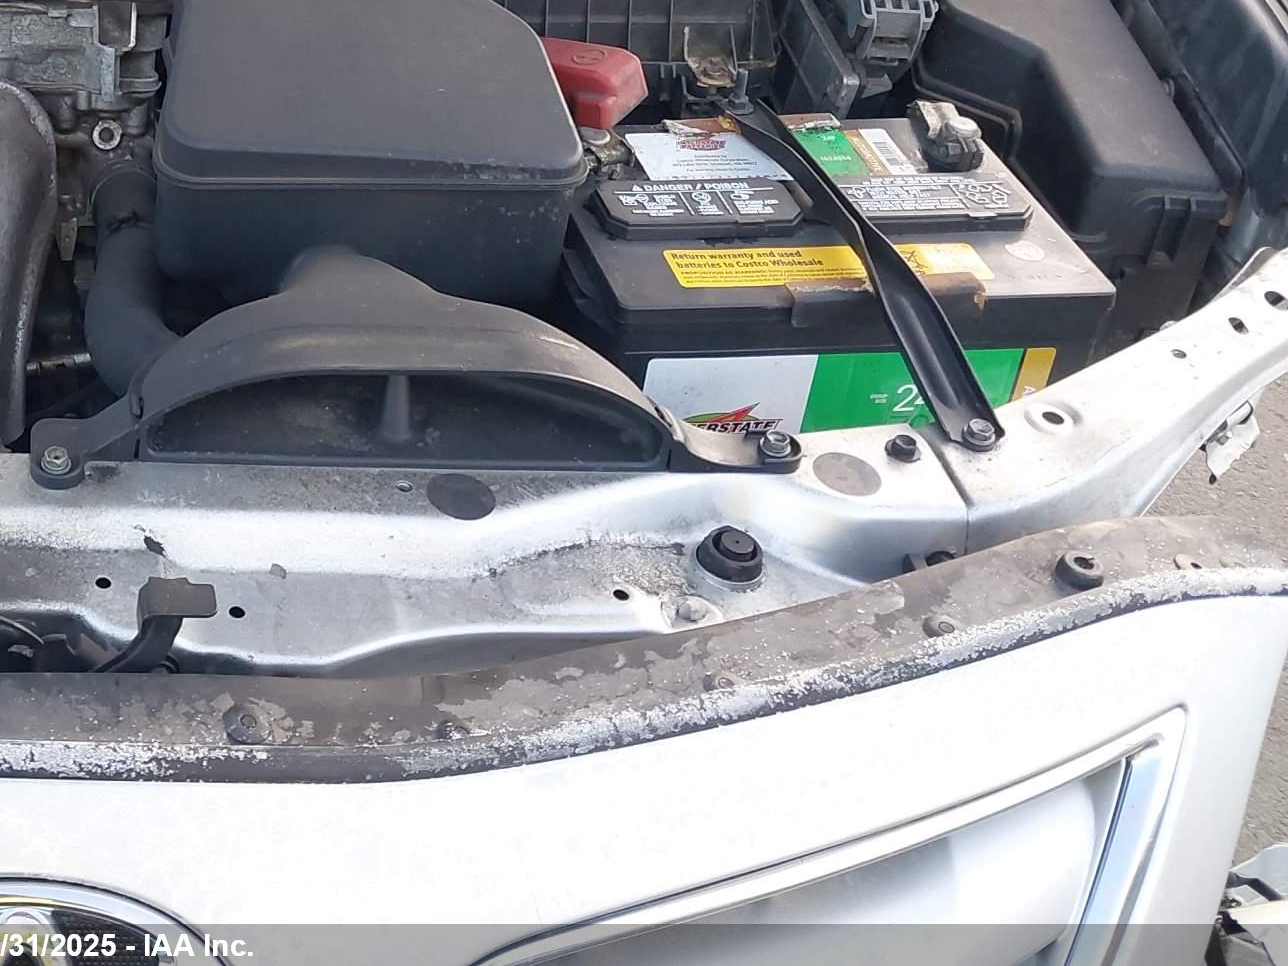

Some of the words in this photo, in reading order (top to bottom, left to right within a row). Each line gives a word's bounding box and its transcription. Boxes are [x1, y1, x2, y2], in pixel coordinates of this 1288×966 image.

[643, 184, 693, 192] DANGER
[704, 182, 750, 190] POISON
[672, 252, 707, 260] Return
[708, 251, 754, 262] warranty
[757, 250, 776, 259] and
[778, 249, 802, 258] used
[677, 260, 722, 269] batteries
[723, 260, 734, 268] to
[736, 259, 770, 268] Costco
[770, 257, 823, 267] Wholesale
[689, 421, 778, 433] ERSTATE
